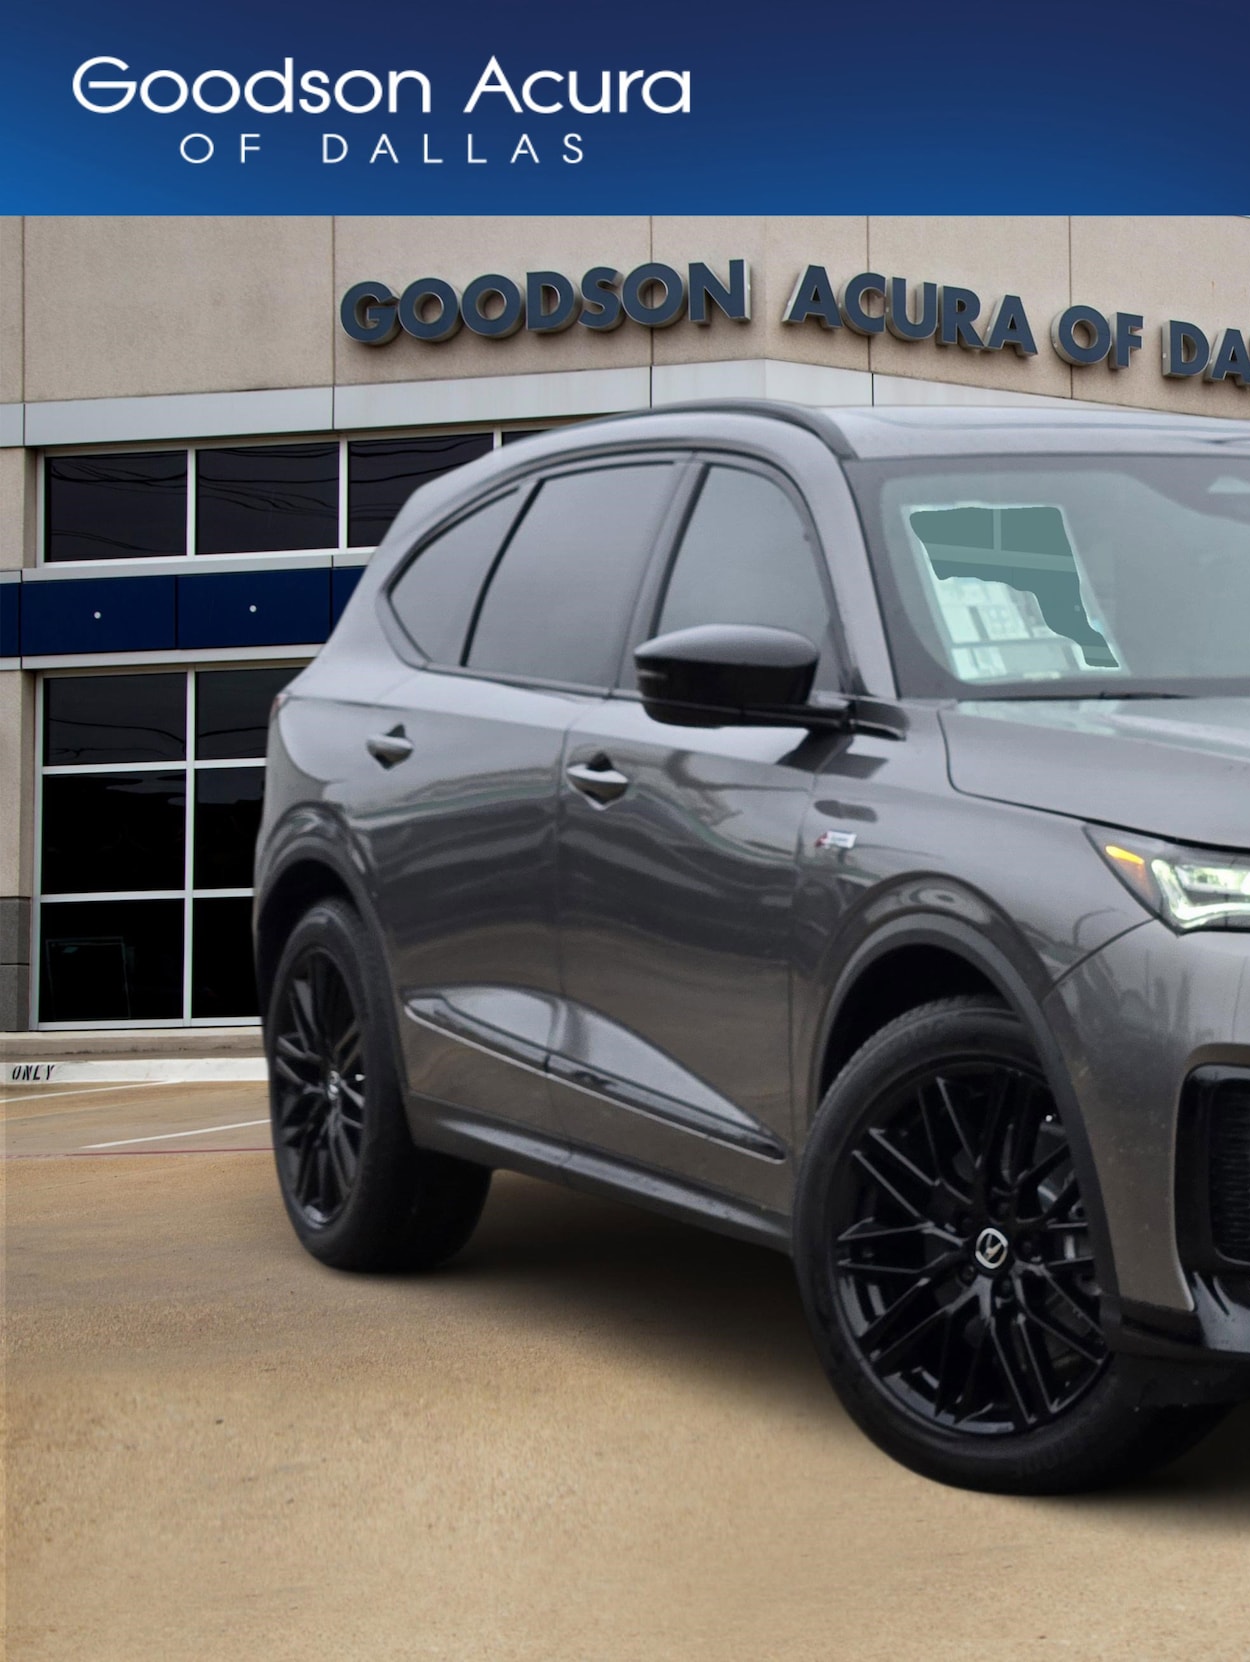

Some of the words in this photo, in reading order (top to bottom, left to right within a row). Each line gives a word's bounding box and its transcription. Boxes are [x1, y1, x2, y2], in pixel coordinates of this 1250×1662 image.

[340, 258, 753, 347] GOODSON
[782, 264, 1038, 356] ACURA
[1051, 305, 1144, 370] OF
[12, 1065, 55, 1081] ONLY
